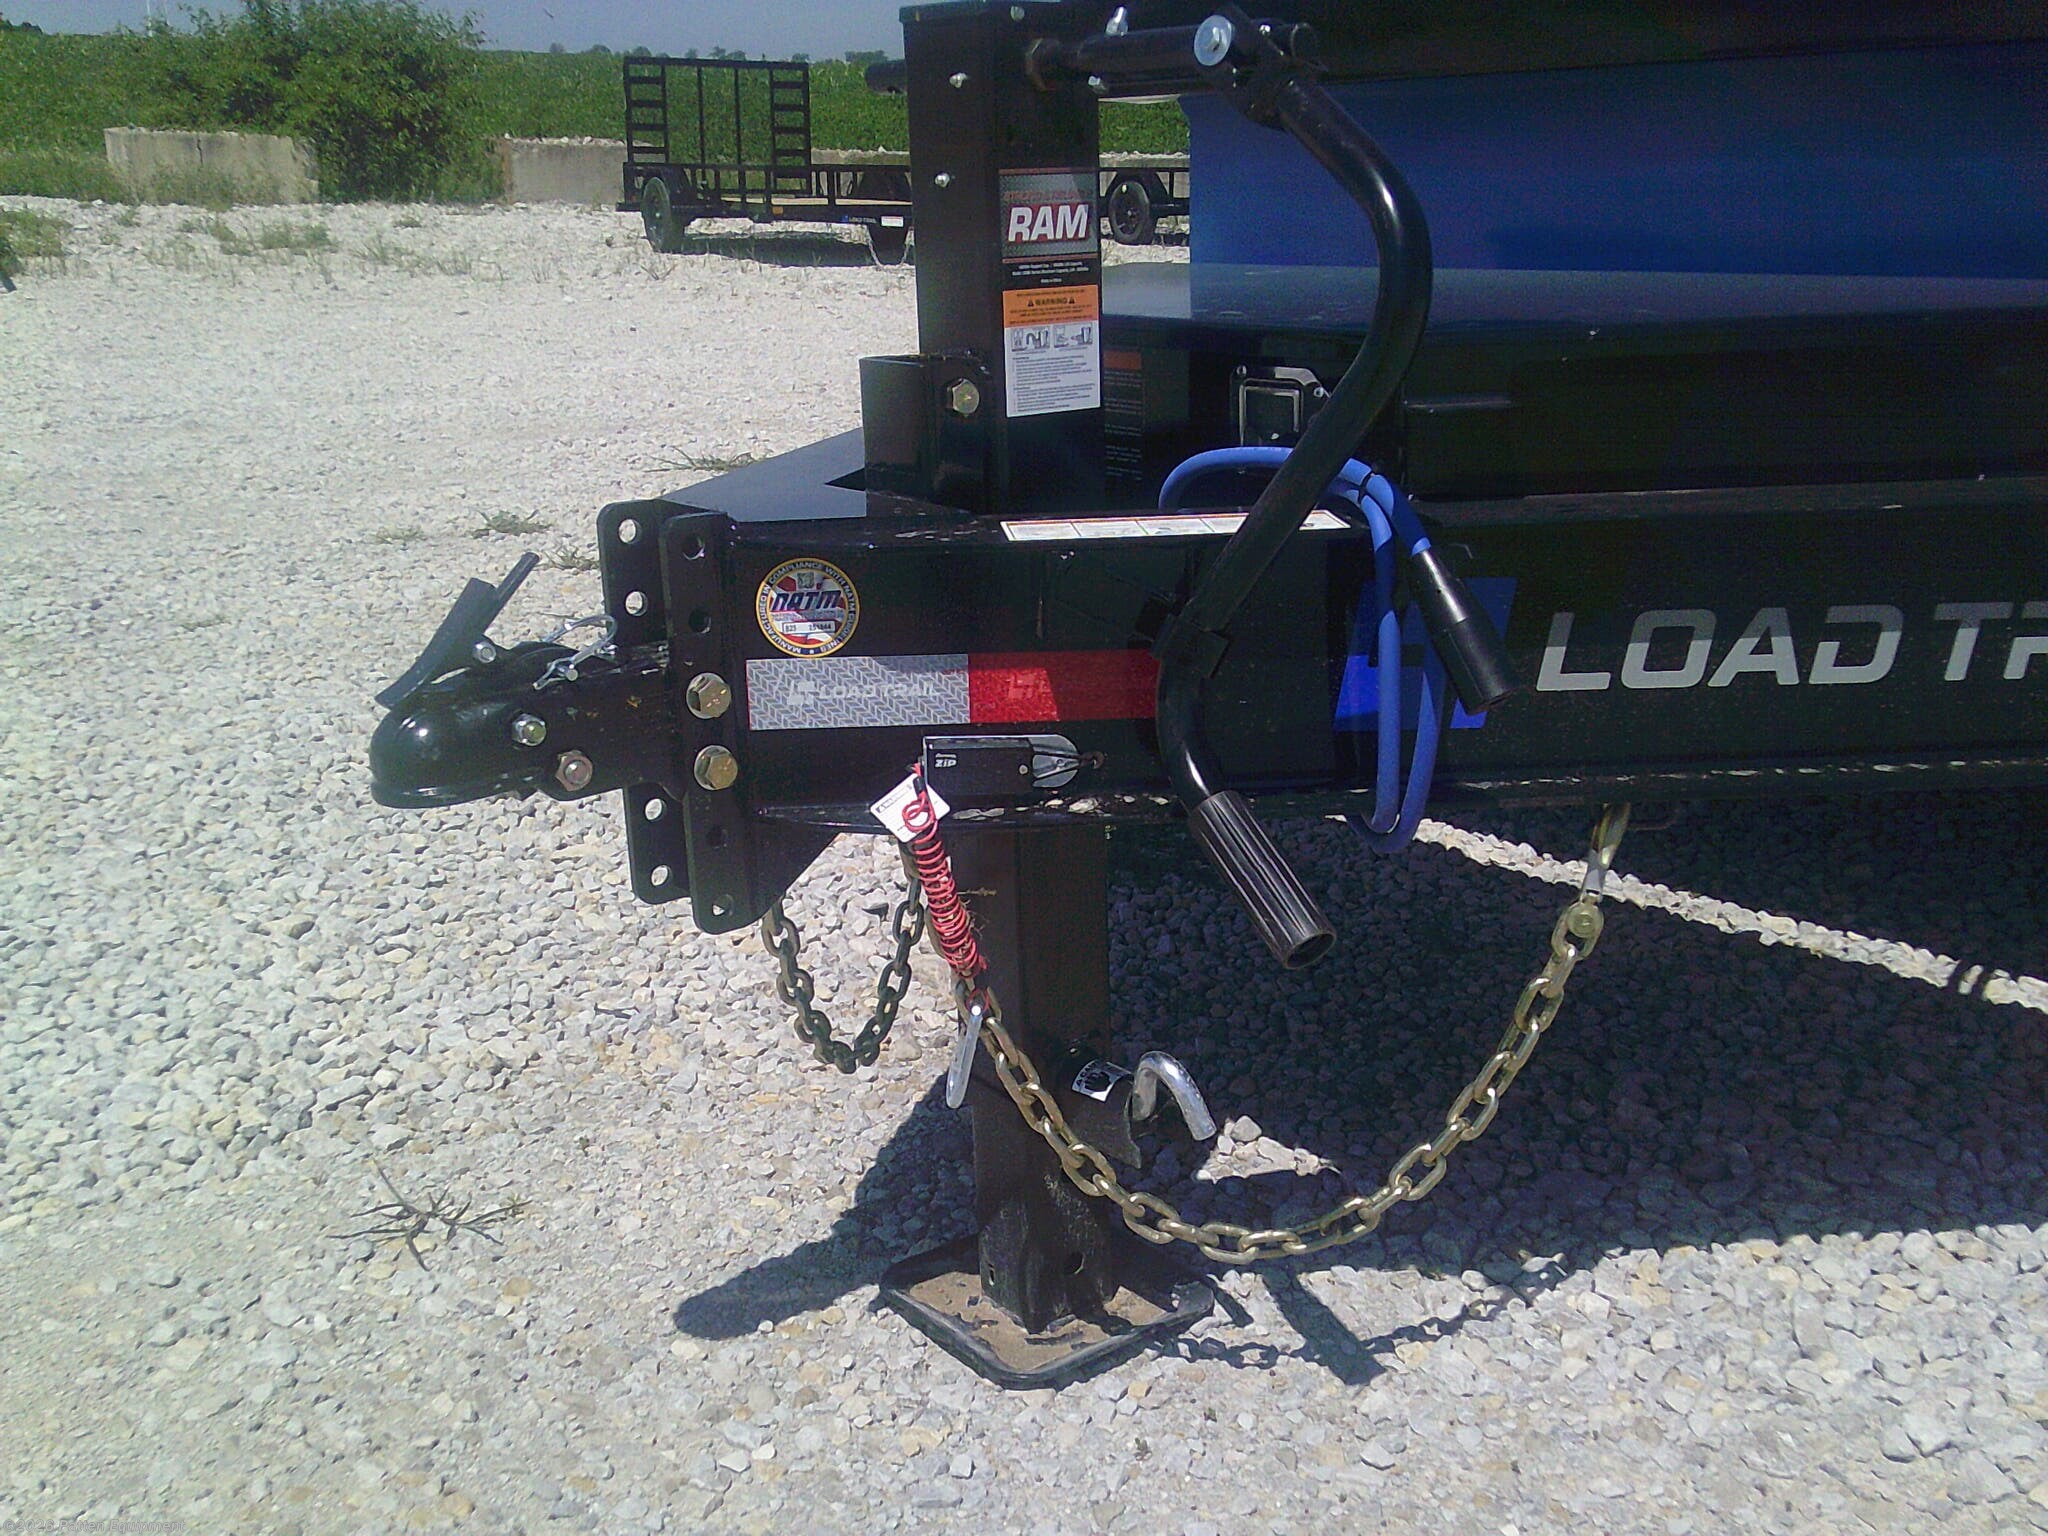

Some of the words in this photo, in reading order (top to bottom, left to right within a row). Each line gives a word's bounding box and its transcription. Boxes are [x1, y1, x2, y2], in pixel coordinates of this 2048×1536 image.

[1008, 204, 1088, 242] RAM
[769, 562, 822, 584] COMPLIANCE
[825, 567, 846, 585] WITH
[1536, 603, 1904, 692] LOAD
